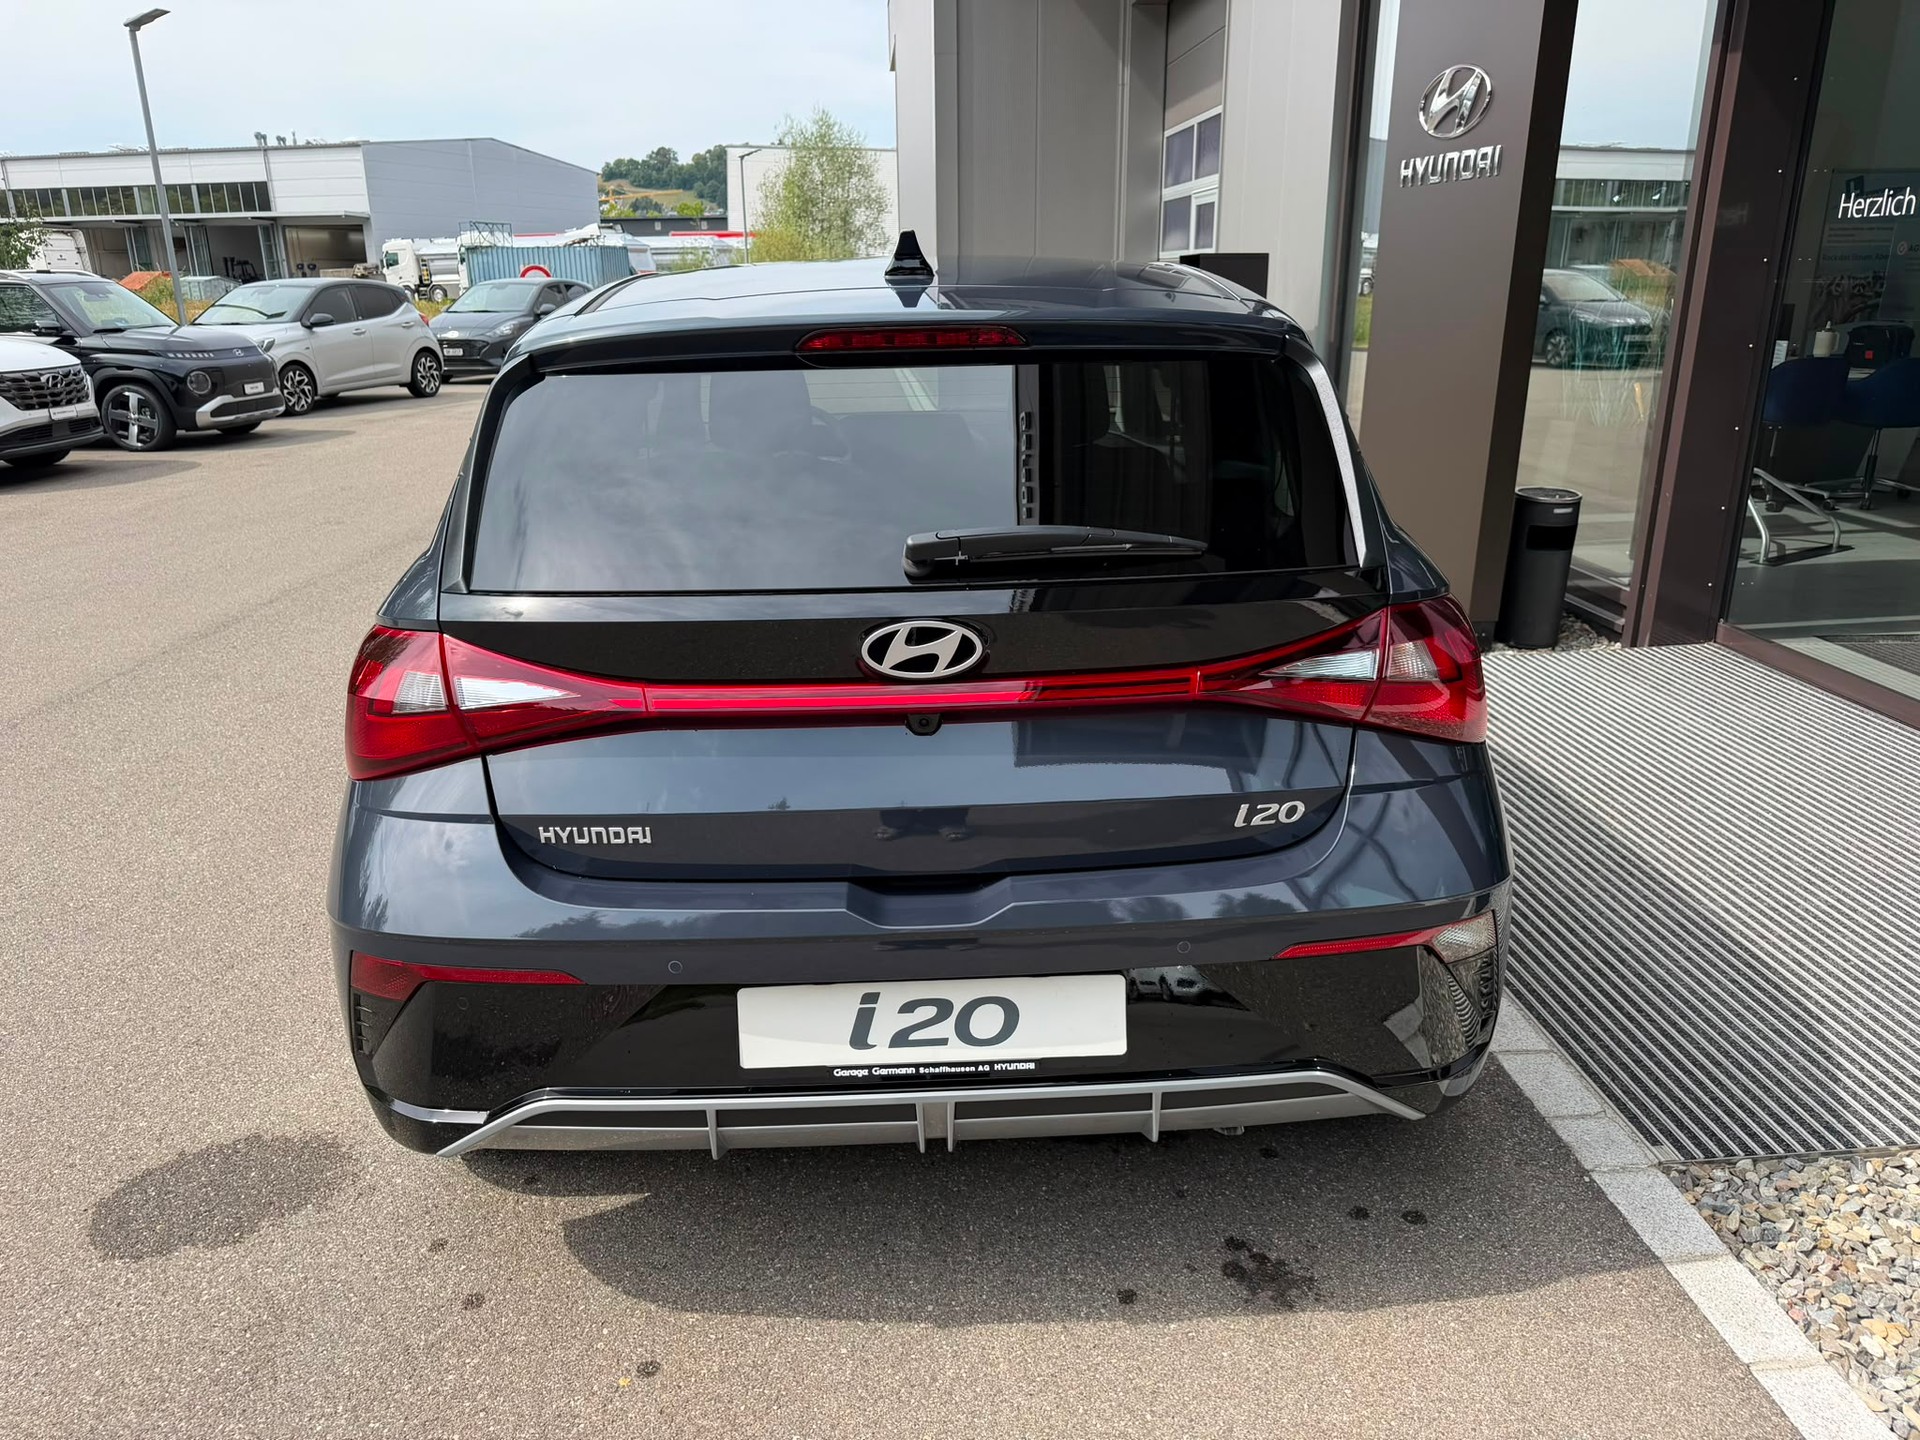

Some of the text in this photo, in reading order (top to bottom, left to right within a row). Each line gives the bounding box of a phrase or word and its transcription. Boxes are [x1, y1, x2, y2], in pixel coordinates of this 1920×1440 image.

[1400, 145, 1502, 187] HYUNDAI
[1838, 186, 1917, 219] Herzlich
[1234, 801, 1305, 827] i20
[538, 827, 652, 844] HYUNDAI
[833, 1068, 869, 1078] Garage
[919, 1065, 976, 1074] Schaffhausen
[977, 1064, 990, 1072] AG
[994, 1062, 1036, 1071] HYUNDAI
